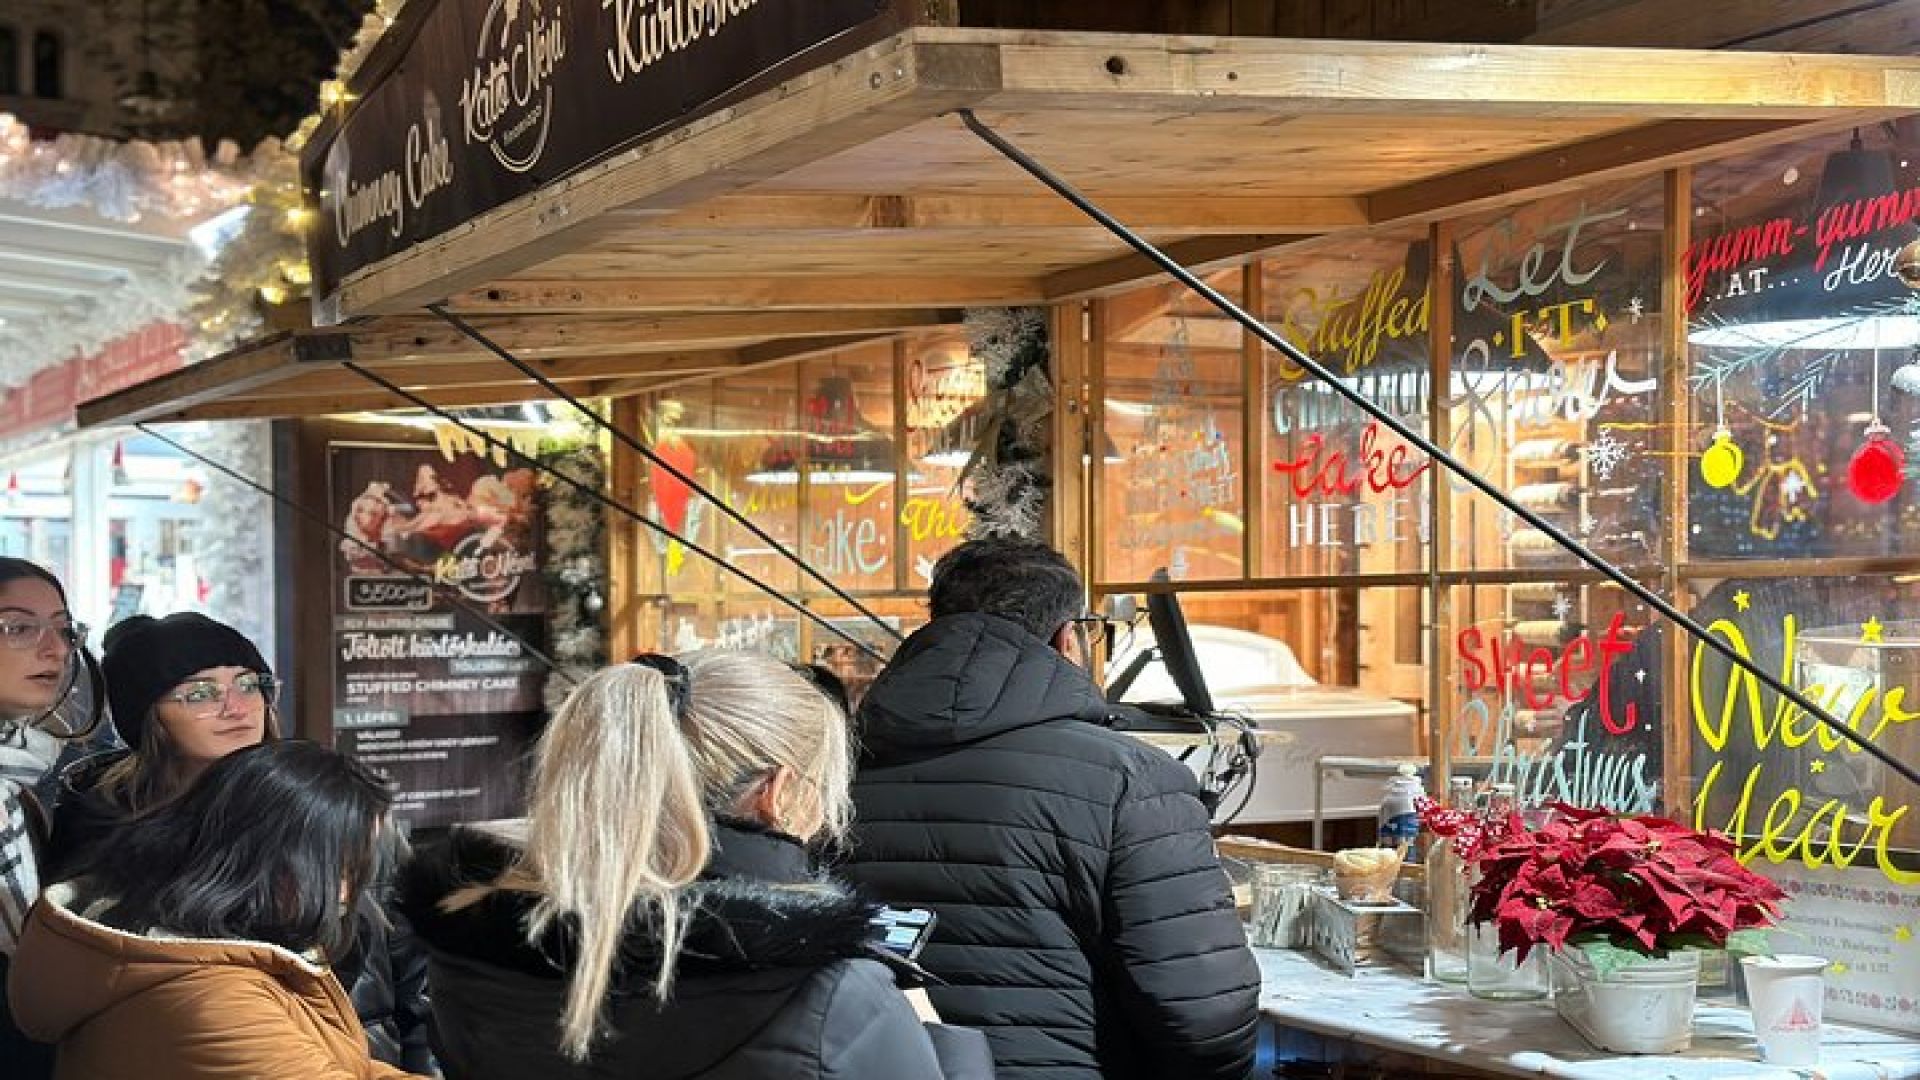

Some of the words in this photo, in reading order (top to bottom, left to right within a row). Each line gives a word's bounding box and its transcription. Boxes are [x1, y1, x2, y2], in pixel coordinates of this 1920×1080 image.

[405, 120, 454, 210] Cake
[1463, 200, 1630, 313] Let
[1279, 266, 1431, 380] Stuffed
[1457, 611, 1637, 735] Sweet
[1692, 613, 1920, 752] New
[1692, 760, 1920, 884] Year
